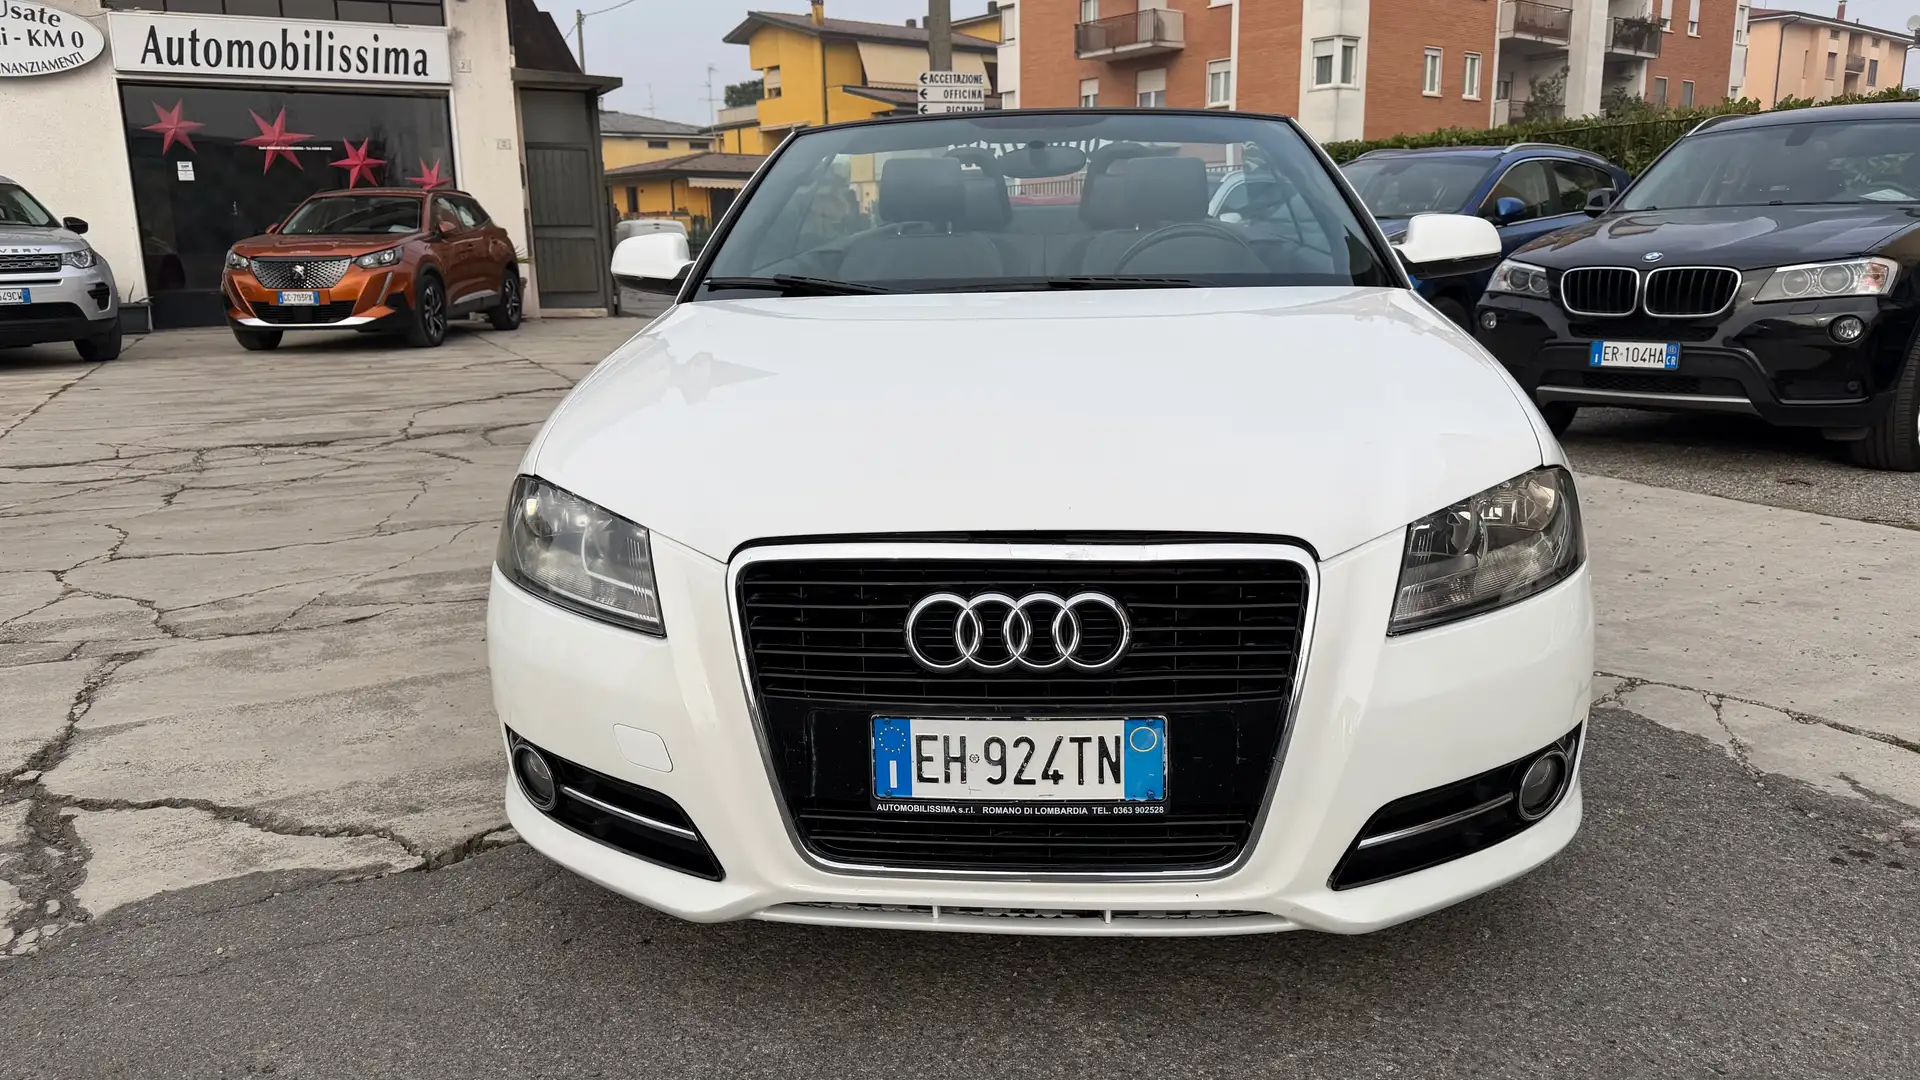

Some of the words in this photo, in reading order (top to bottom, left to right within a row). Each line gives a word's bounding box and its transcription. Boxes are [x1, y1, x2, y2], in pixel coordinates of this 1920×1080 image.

[26, 29, 65, 48] KM
[71, 31, 84, 48] 0
[141, 24, 429, 77] Automobilissima
[0, 51, 85, 74] NANZIAMENTI
[929, 73, 983, 85] ACCETTAZIONE
[943, 89, 982, 99] OFFICINA
[1666, 356, 1676, 366] CR
[876, 803, 957, 814] AUTOMOBILISSIMA
[958, 806, 976, 815] s.r.l.
[982, 806, 1022, 815] ROMANO
[1023, 807, 1033, 815] DI
[1034, 807, 1089, 815] LOMBARDIA
[1091, 806, 1112, 815] TEL.
[1113, 806, 1133, 814] 0363
[1134, 805, 1165, 814] 902528
